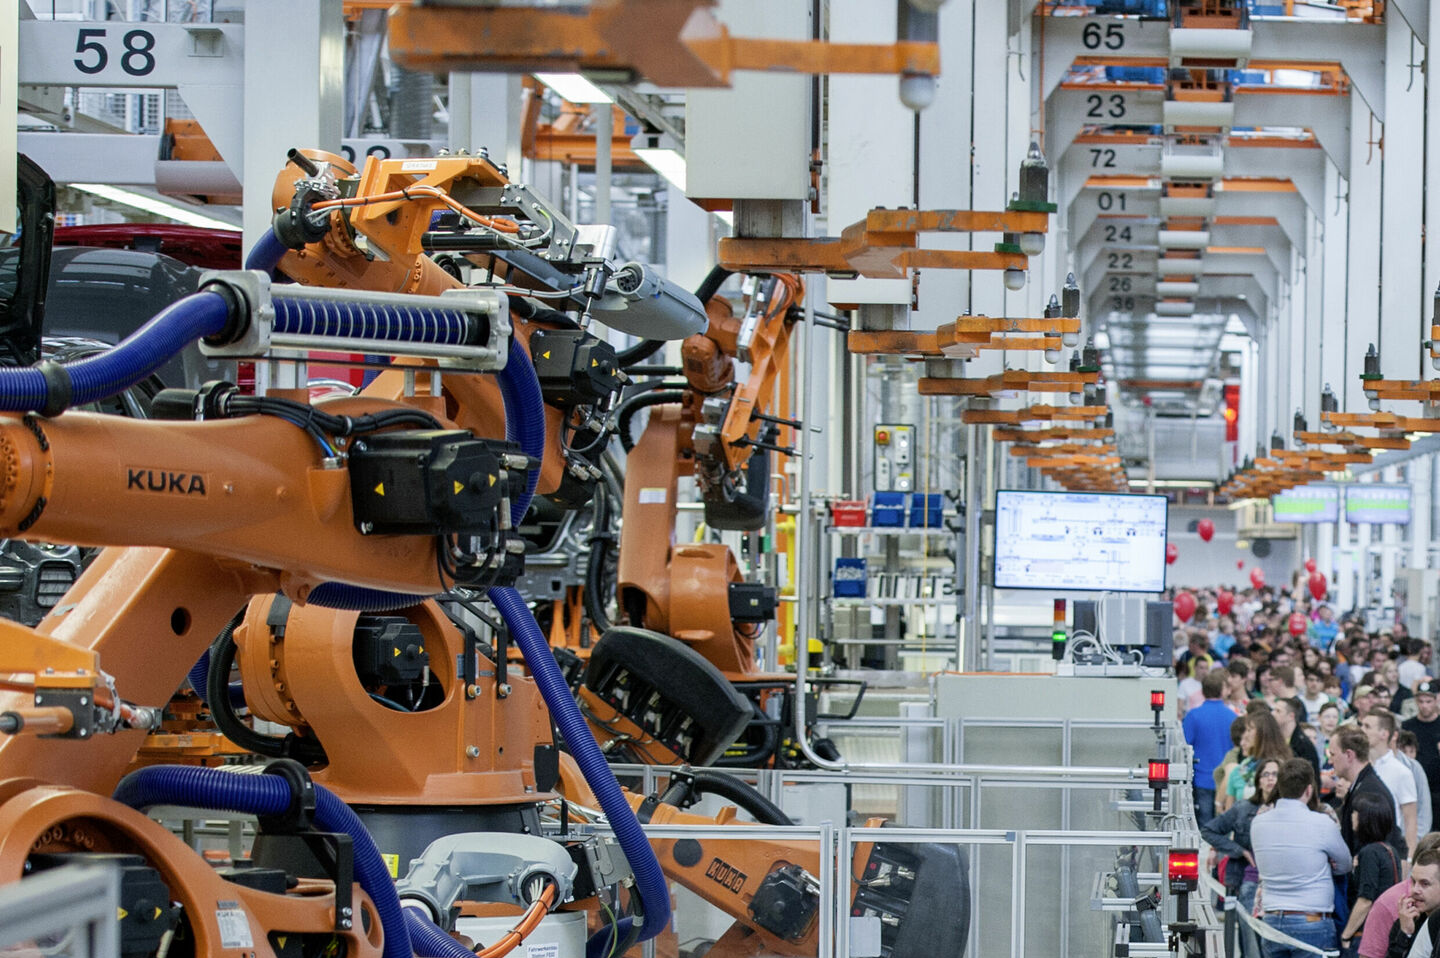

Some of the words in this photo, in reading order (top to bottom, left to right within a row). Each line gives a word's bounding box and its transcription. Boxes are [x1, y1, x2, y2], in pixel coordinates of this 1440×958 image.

[1082, 22, 1125, 50] 65
[73, 28, 156, 76] 58
[1087, 94, 1127, 118] 23
[1090, 149, 1117, 168] 72
[1098, 192, 1127, 211] 01
[1105, 225, 1133, 244] 24
[1109, 253, 1134, 269] 22
[1110, 277, 1133, 292] 26
[127, 468, 206, 495] KUKA
[707, 858, 745, 892] KUKA
